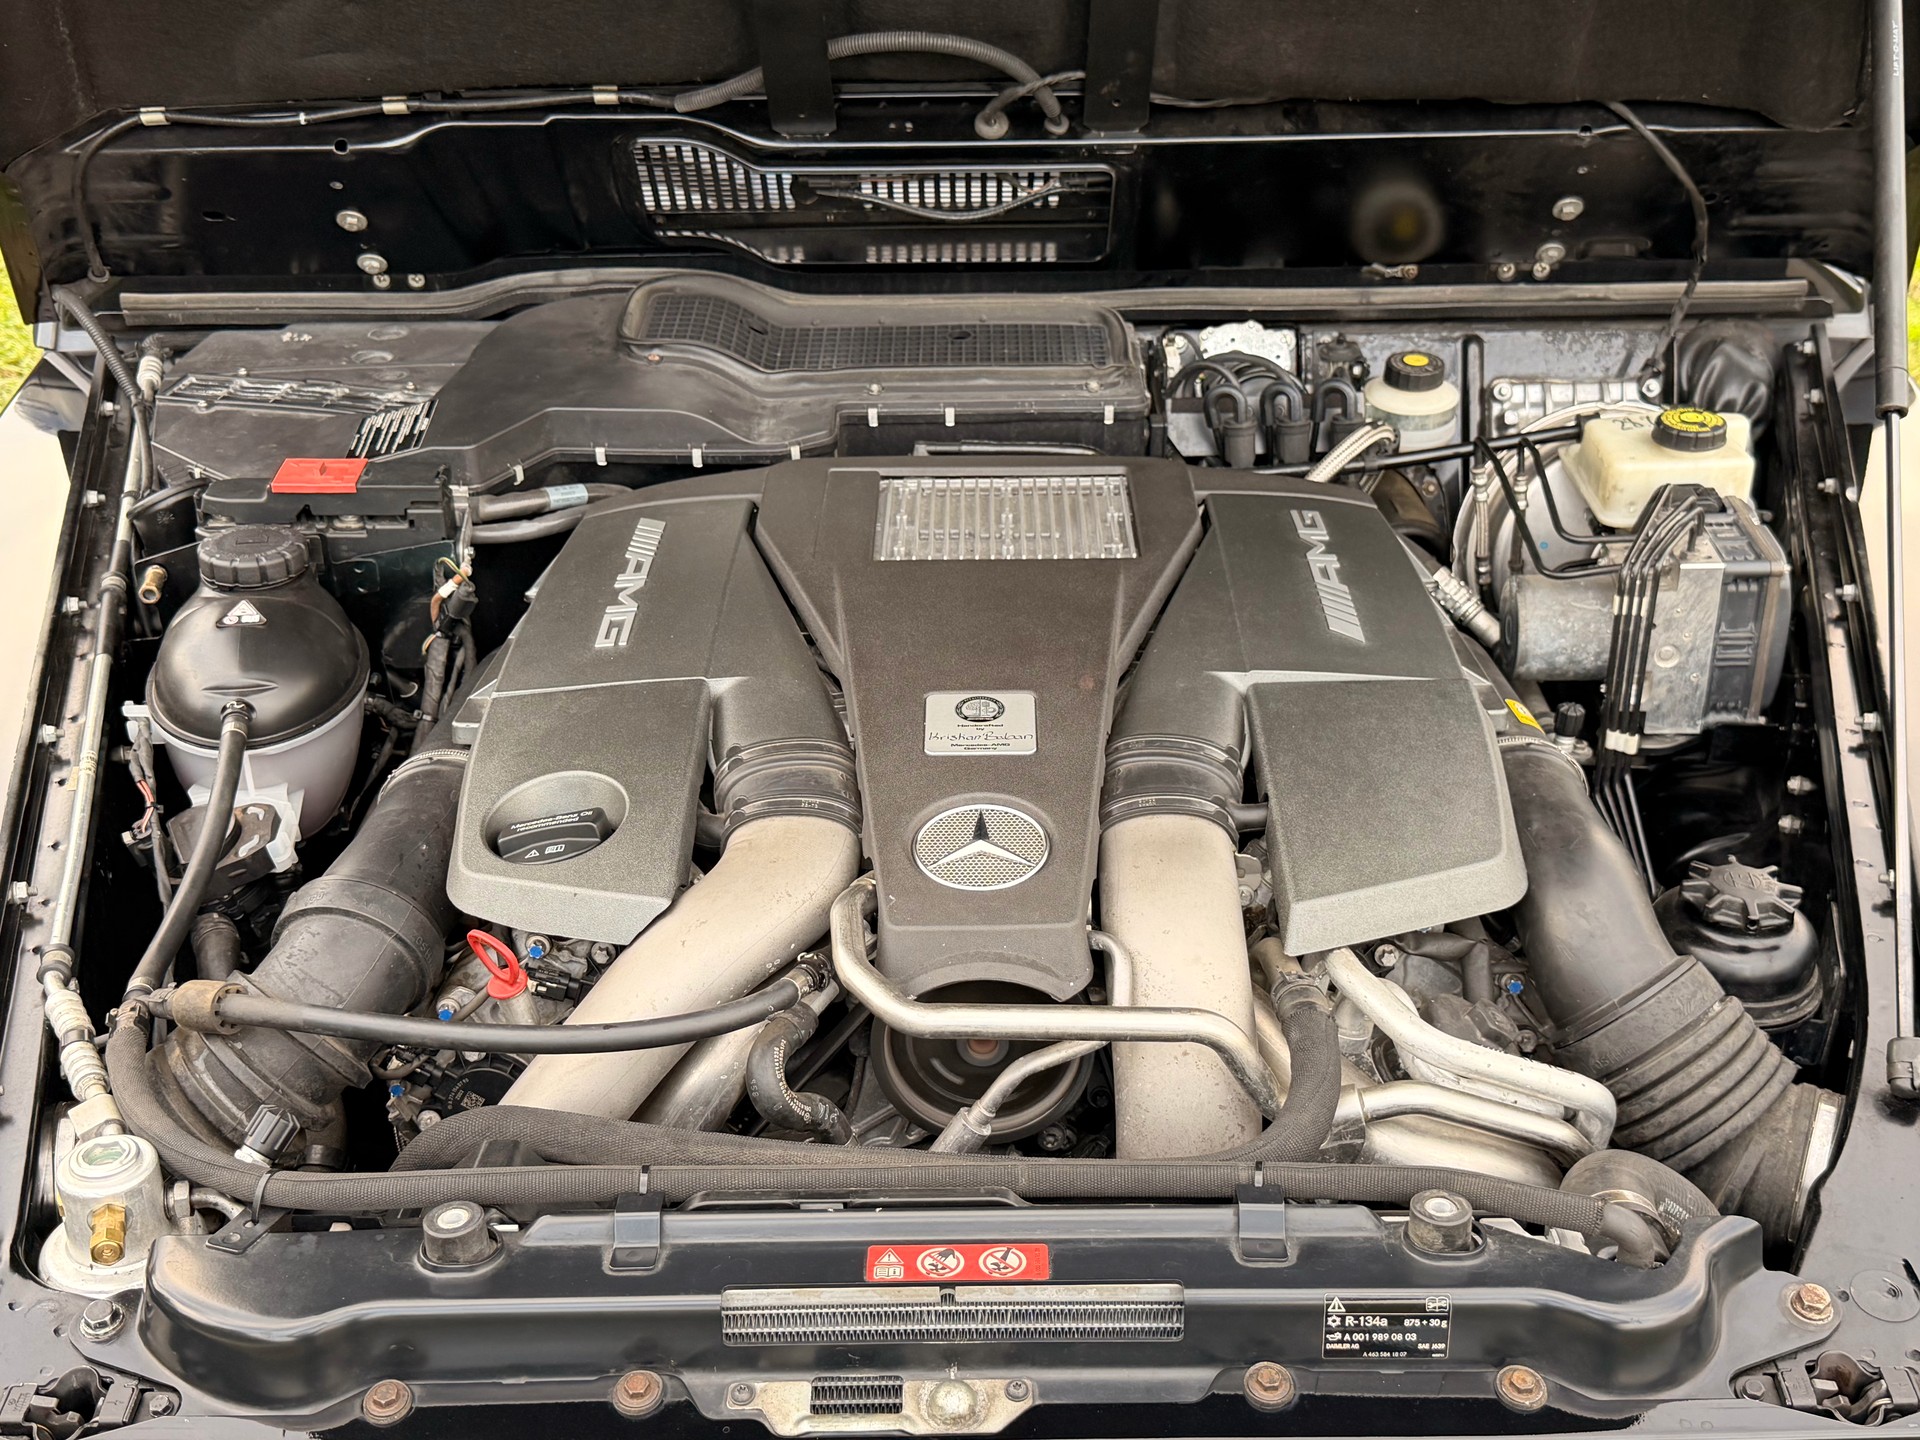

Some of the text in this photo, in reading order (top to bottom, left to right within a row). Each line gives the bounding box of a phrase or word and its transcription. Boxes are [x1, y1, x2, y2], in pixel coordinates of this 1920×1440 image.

[1290, 510, 1353, 603] AMG
[595, 542, 659, 647] AMG
[1343, 1333, 1417, 1341] A 001 989 08 03
[1345, 1315, 1388, 1327] R-134a
[1403, 1318, 1420, 1327] 875
[1428, 1318, 1441, 1327] 30
